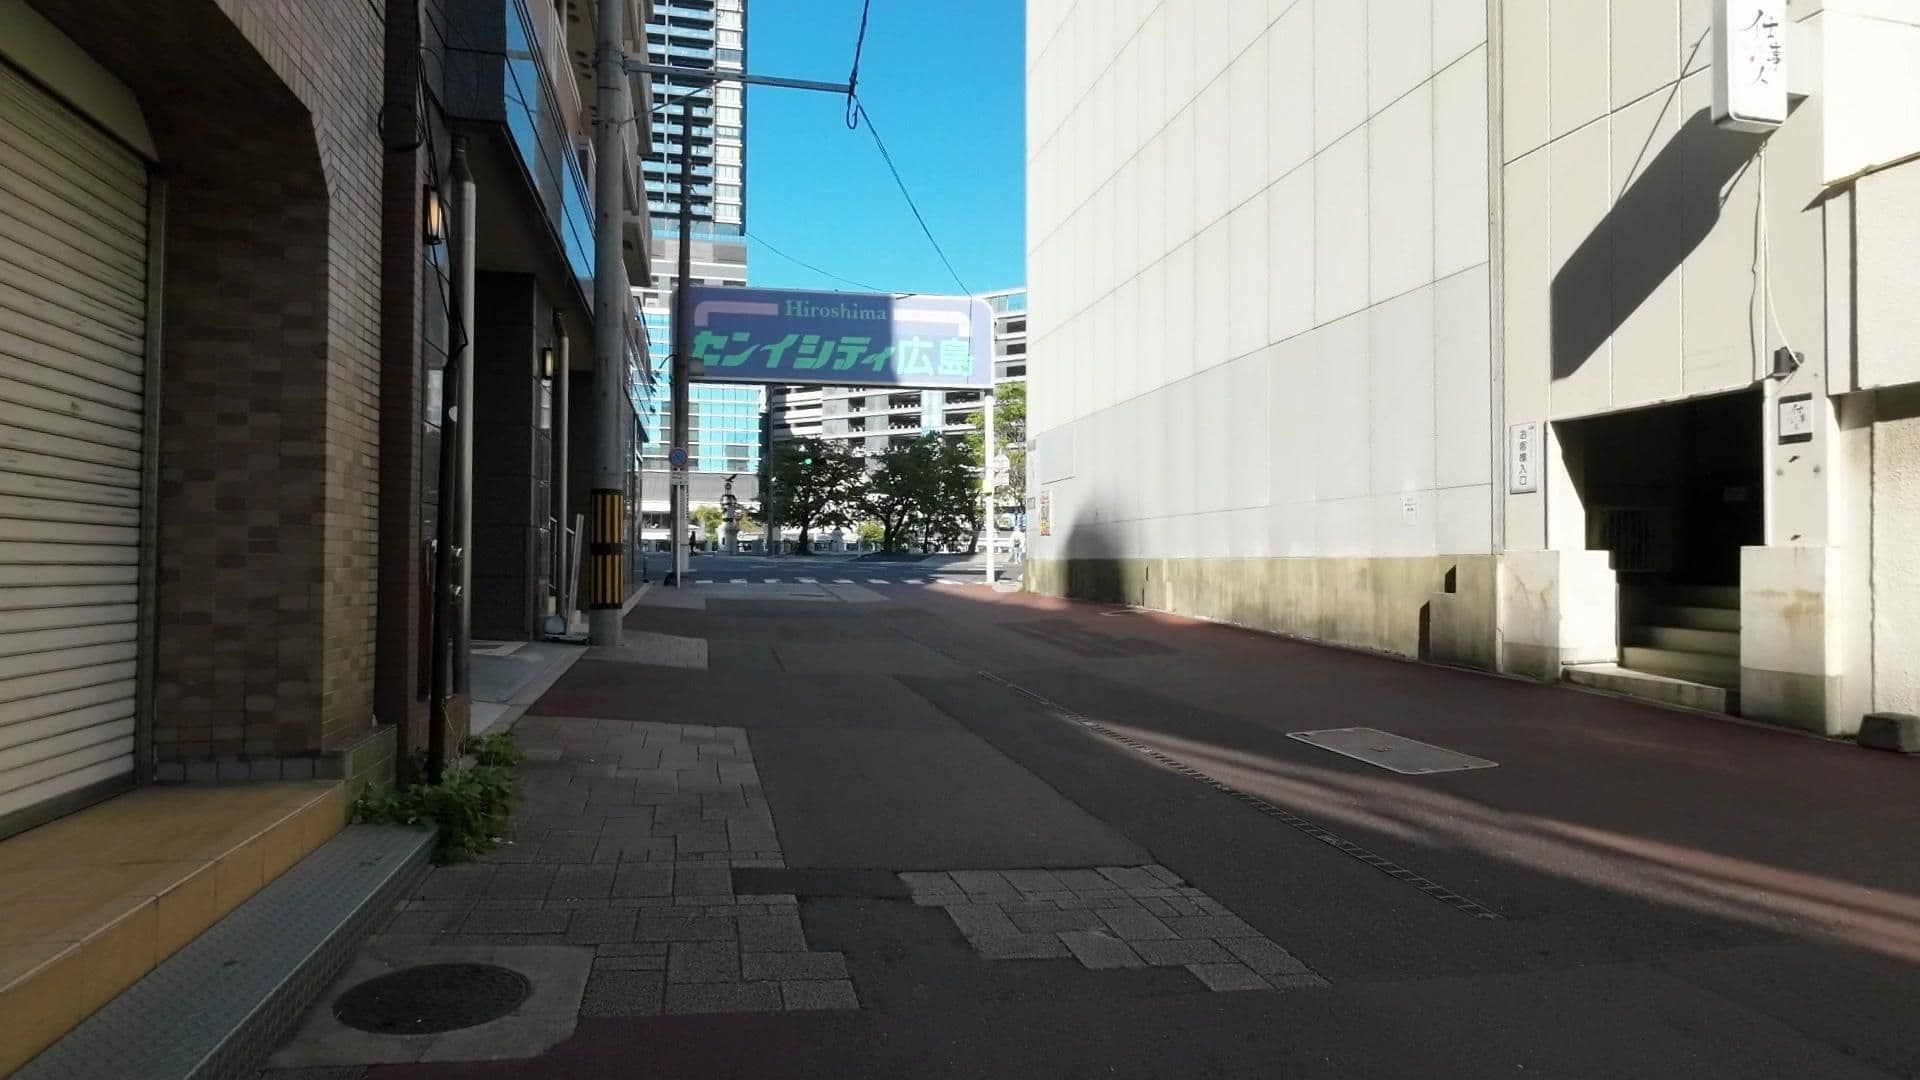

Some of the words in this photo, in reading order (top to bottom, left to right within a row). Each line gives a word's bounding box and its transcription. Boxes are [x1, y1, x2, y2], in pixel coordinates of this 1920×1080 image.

[1739, 9, 1782, 86] 仕事人
[783, 300, 888, 321] Hiroshima
[691, 330, 975, 377] センイシティ広島
